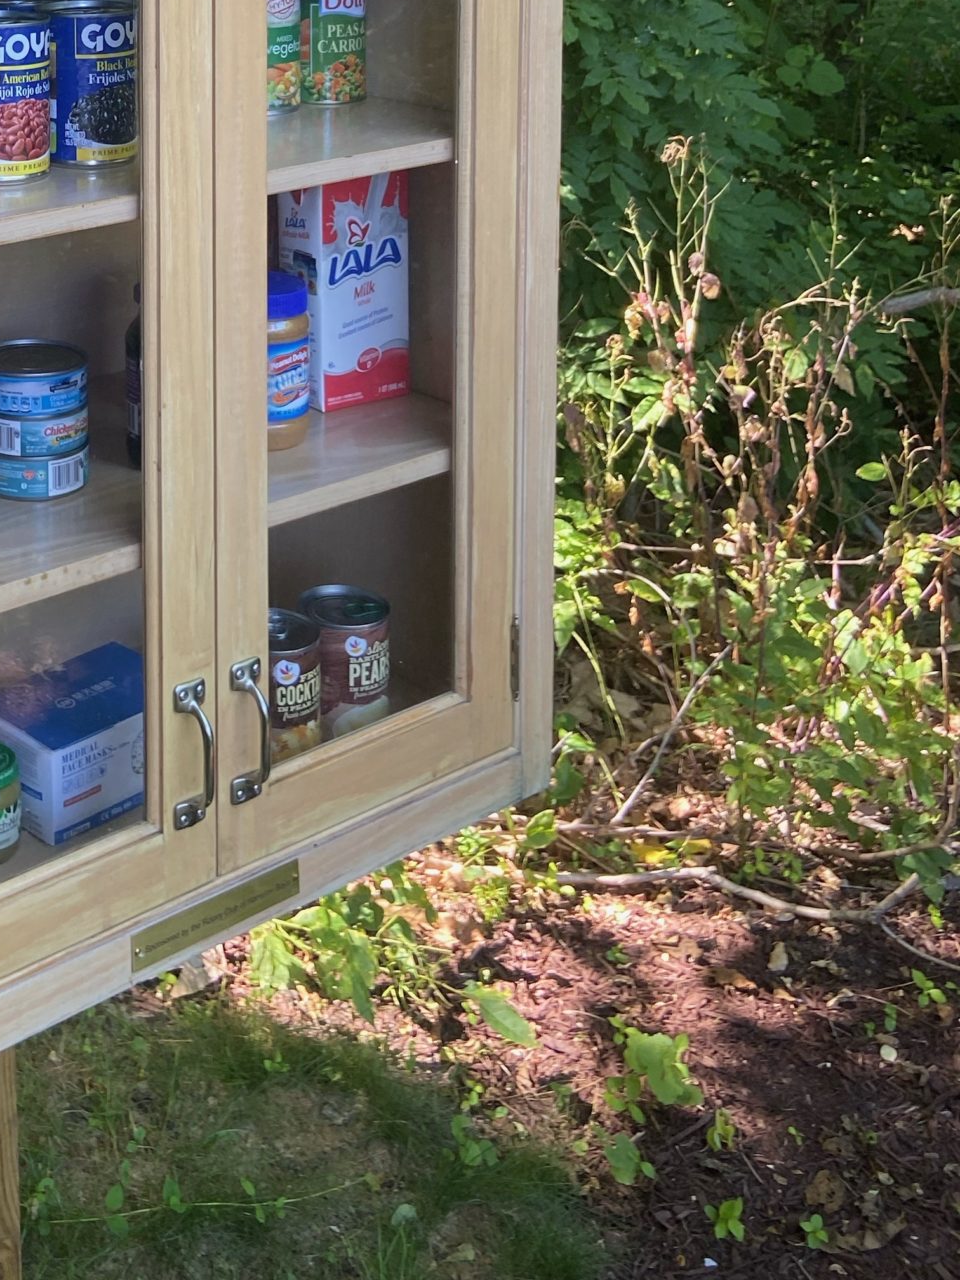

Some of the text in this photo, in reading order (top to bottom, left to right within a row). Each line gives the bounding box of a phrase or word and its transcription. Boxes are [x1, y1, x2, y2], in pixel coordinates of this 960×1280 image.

[327, 23, 359, 38] PEAS
[96, 60, 124, 72] Black
[2, 71, 40, 84] American
[88, 72, 126, 87] Frijoles
[15, 85, 35, 99] Rojo
[328, 237, 402, 286] LALA
[354, 280, 376, 300] Milk
